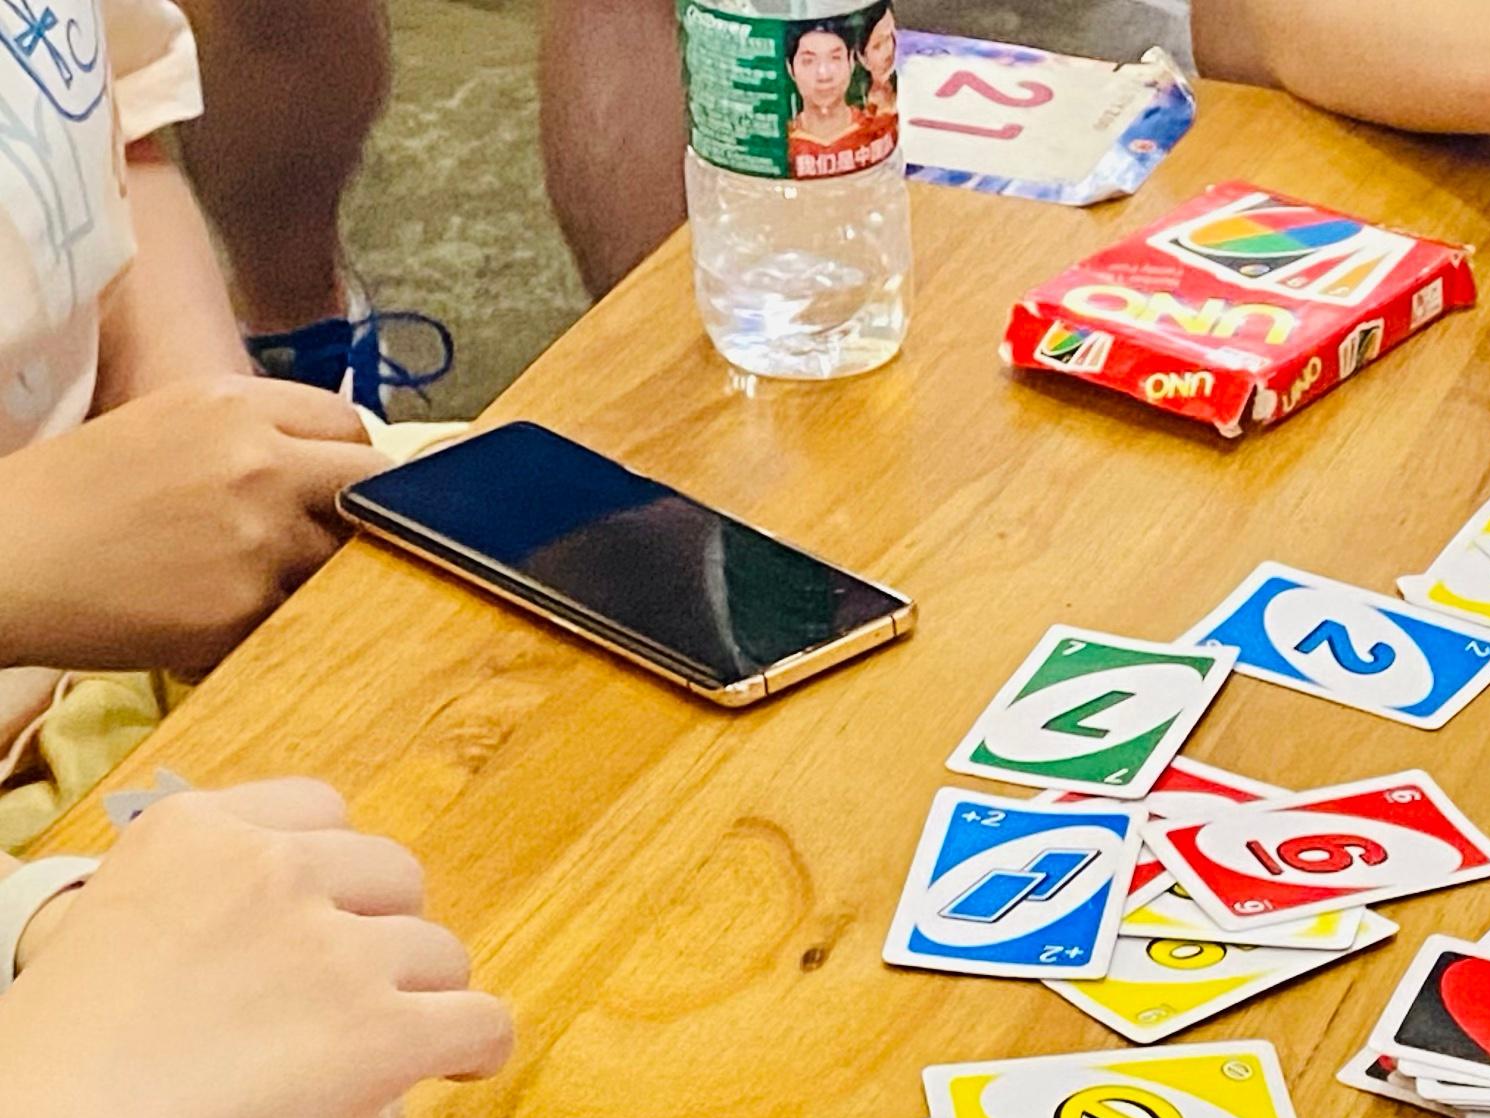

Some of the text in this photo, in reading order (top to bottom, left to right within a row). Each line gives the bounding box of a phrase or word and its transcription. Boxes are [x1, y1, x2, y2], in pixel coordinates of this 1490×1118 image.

[907, 71, 1054, 140] 21
[1062, 284, 1299, 346] UNO
[1145, 370, 1214, 400] UNO
[1281, 356, 1323, 411] UNO
[1294, 619, 1396, 675] 2
[1465, 641, 1490, 657] 2
[1041, 690, 1136, 739] 7
[962, 810, 1006, 827] +2
[1039, 945, 1083, 963] +2
